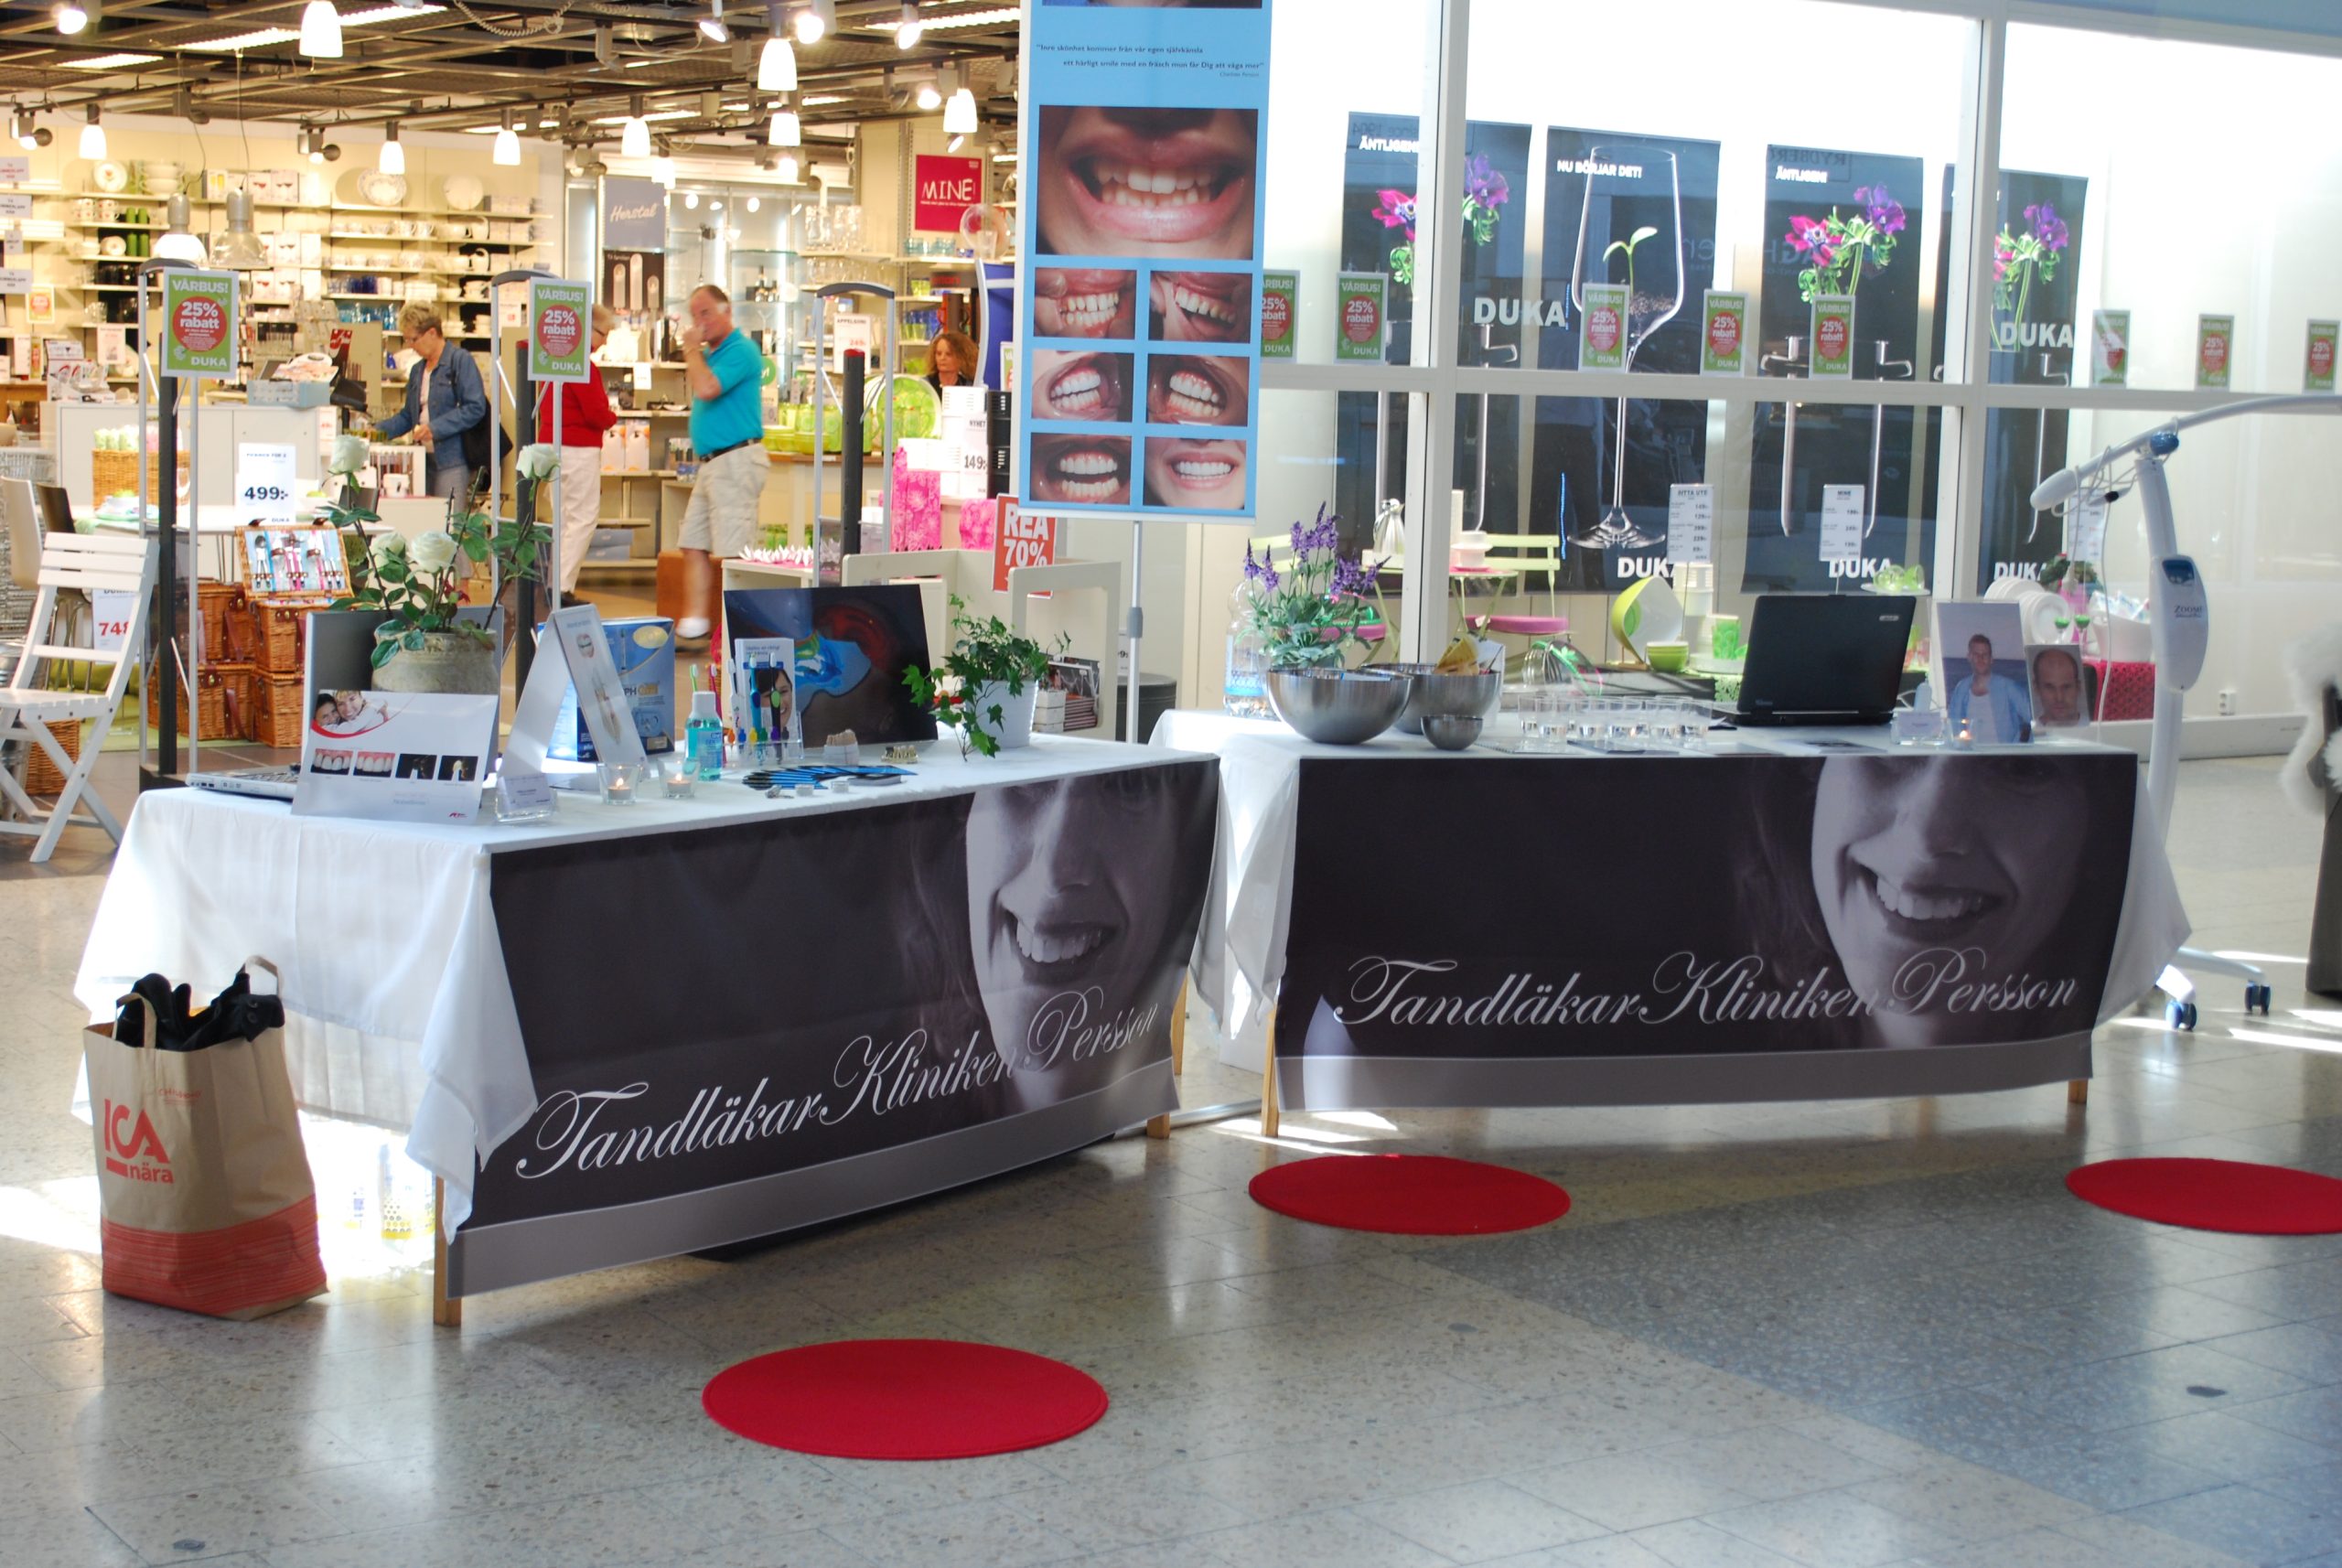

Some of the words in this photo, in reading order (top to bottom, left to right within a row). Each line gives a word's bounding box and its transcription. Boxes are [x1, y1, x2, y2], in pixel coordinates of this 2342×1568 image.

[1201, 61, 1214, 70] Dig
[1556, 160, 1574, 173] NU
[1574, 160, 1617, 177] BÖRJAR
[1617, 165, 1643, 179] DET!
[172, 279, 229, 293] VÅRBUS!
[1341, 281, 1380, 293] VÅRBUS!
[537, 288, 584, 302] VÅRBUS!
[1587, 292, 1623, 304] VÅRBUS!
[181, 301, 219, 317] 25%
[1347, 300, 1373, 314] 25%
[1708, 297, 1743, 310] VÅRBUS!
[543, 309, 575, 325] 25%
[1474, 296, 1567, 328] DUKA
[1592, 310, 1617, 324] 25%
[180, 317, 220, 329] rabatt
[1346, 314, 1374, 323] rabatt
[1714, 316, 1736, 328] 25%
[543, 324, 576, 336] rabatt
[1591, 324, 1617, 334] rabatt
[1821, 321, 1843, 332] 25%
[1712, 328, 1736, 338] rabatt
[1821, 332, 1844, 341] rabatt
[1999, 320, 2075, 349] DUKA
[1264, 344, 1292, 353] DUKA
[2205, 337, 2224, 348] 25%
[190, 357, 228, 367] DUKA
[1596, 354, 1620, 364] DUKA
[1717, 359, 1739, 367] DUKA
[552, 361, 582, 372] DUKA
[970, 419, 986, 428] NYHET
[244, 486, 289, 500] 499:-
[1004, 502, 1048, 542] REA
[1004, 538, 1047, 567] 70%
[1617, 556, 1673, 578] DUK
[1333, 955, 1641, 1026] Tandläkar
[1638, 950, 1881, 1025] Kliniken
[1886, 946, 2079, 1017] Persson
[515, 1076, 822, 1179] Tandläkar
[819, 1027, 1017, 1125] Kliniken
[1023, 985, 1159, 1074] Persson
[103, 1097, 171, 1165] ICA
[129, 1162, 175, 1184] nära
